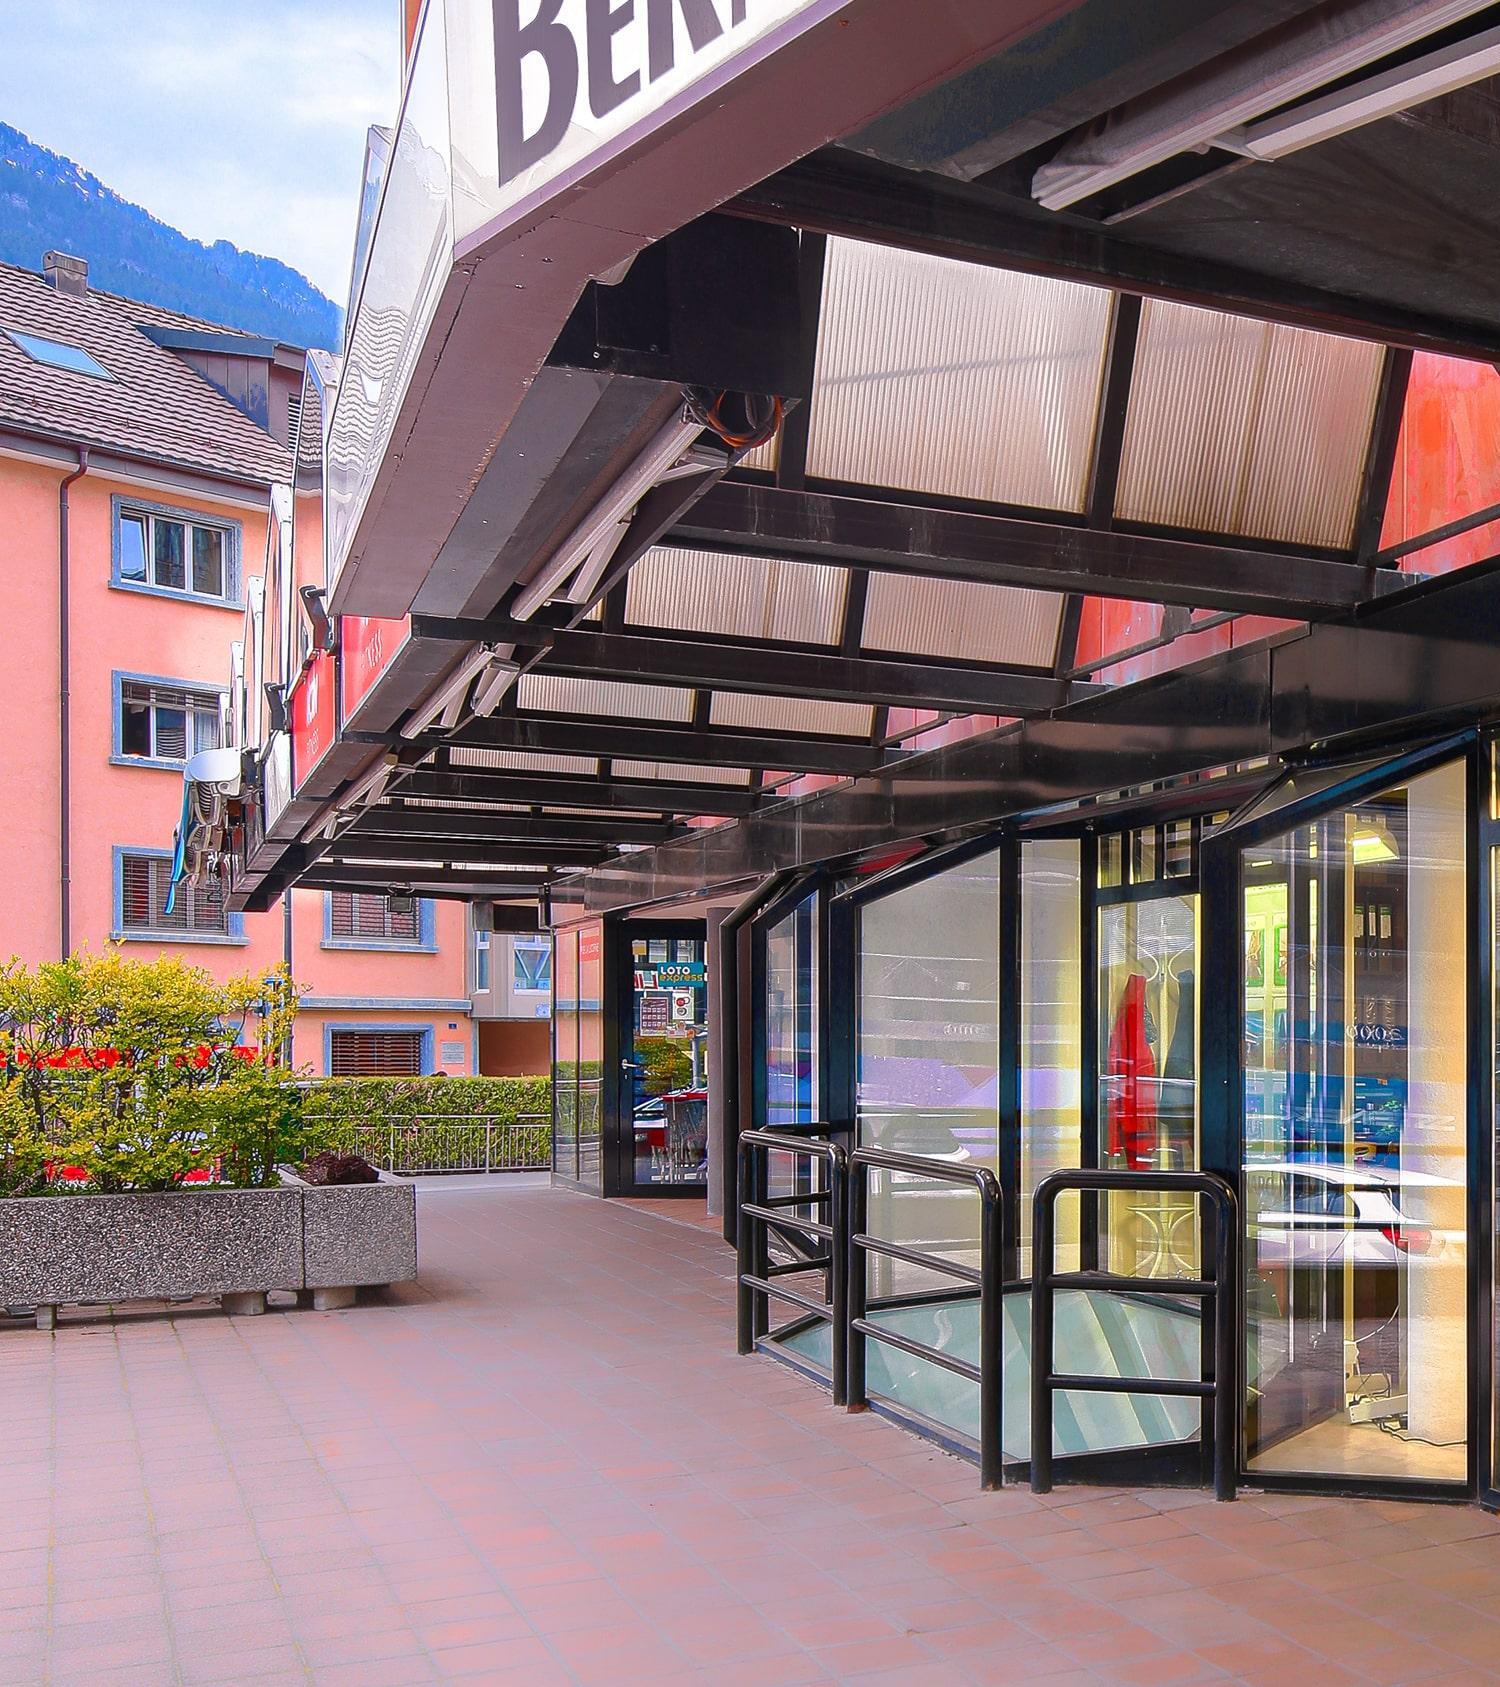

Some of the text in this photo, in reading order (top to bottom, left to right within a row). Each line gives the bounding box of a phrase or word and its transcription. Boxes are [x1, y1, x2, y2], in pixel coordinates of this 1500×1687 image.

[493, 0, 746, 188] BER
[660, 966, 690, 975] LOTO
[659, 974, 703, 983] express
